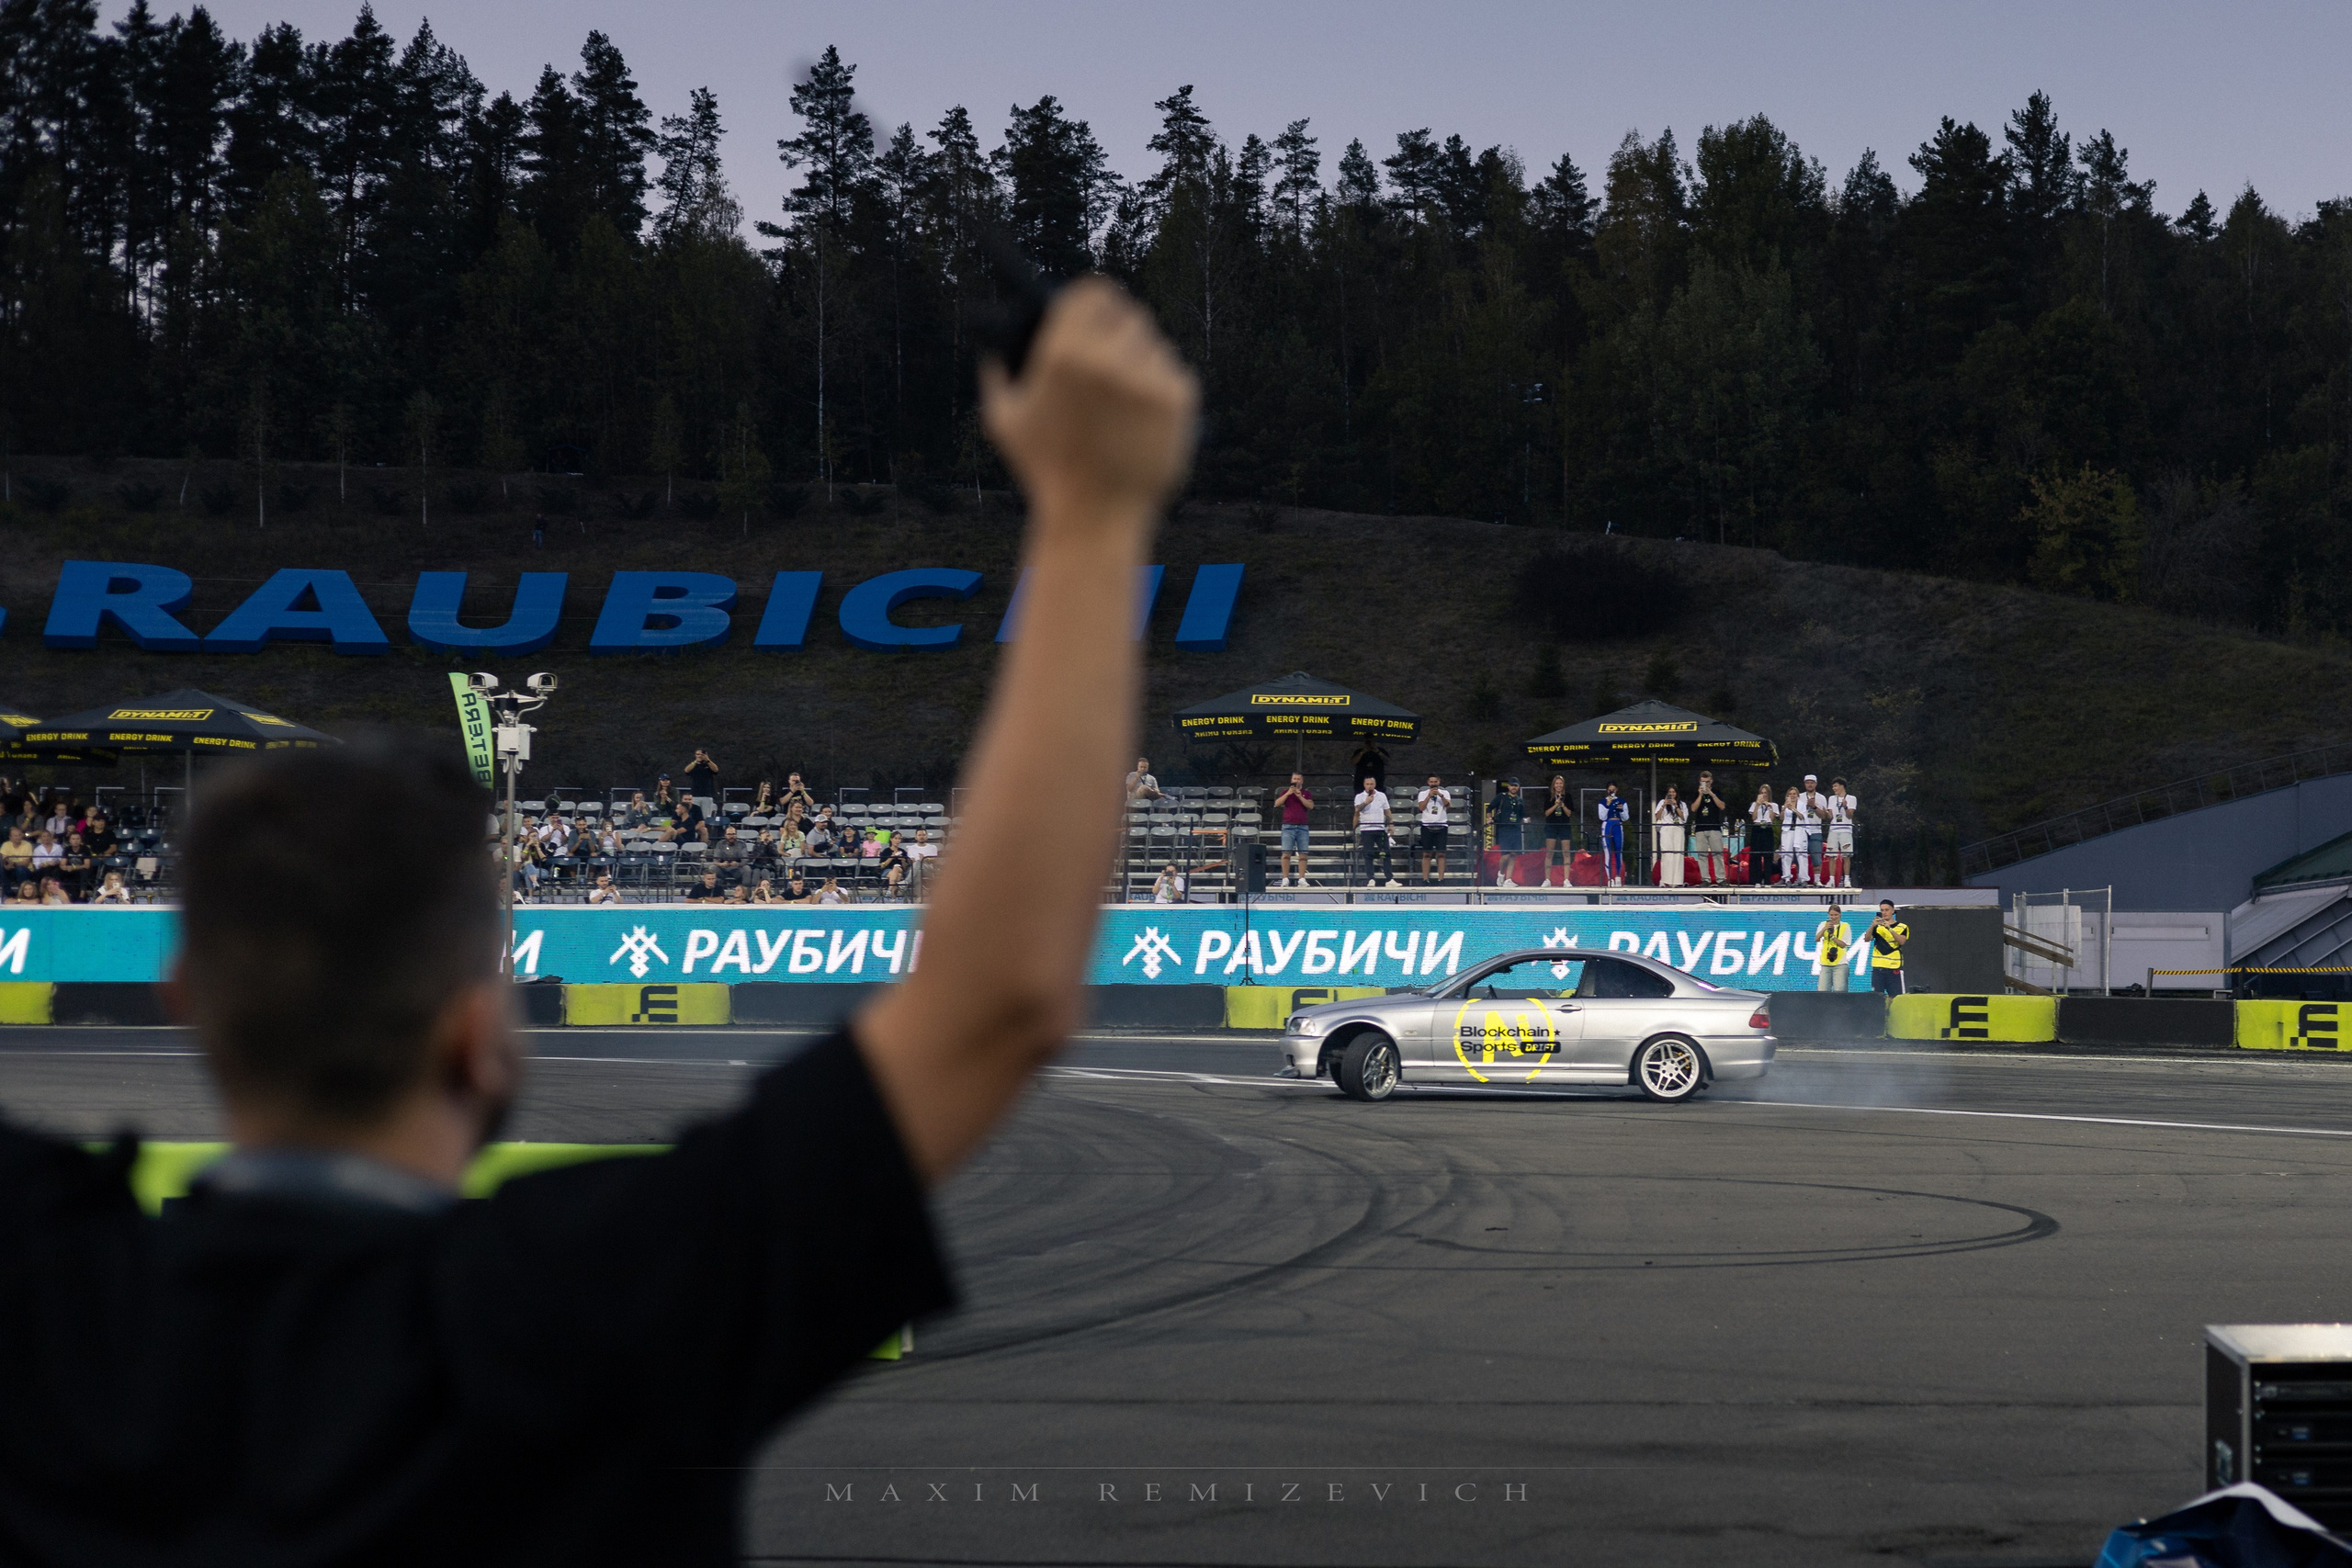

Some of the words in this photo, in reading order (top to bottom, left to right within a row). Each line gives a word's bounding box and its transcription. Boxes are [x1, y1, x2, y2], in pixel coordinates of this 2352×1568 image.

[1182, 717, 1216, 727] ENERGY
[1217, 716, 1245, 725] DRINK
[1302, 716, 1330, 724] DRINK
[1351, 717, 1385, 727] ENERGY
[1386, 720, 1415, 730] DRINK
[26, 732, 60, 741] ENERGY
[61, 732, 89, 740] DRINK
[109, 732, 143, 741] ENERGY
[145, 734, 173, 742] DRINK
[193, 737, 227, 746] ENERGY
[229, 739, 256, 750] DRINK
[1527, 745, 1561, 753] ENERGY
[1194, 930, 1465, 976] РАУБИЧИ
[1460, 1026, 1550, 1037] Blockchain
[1460, 1041, 1517, 1054] Sports
[1525, 1043, 1556, 1052] DRIFT
